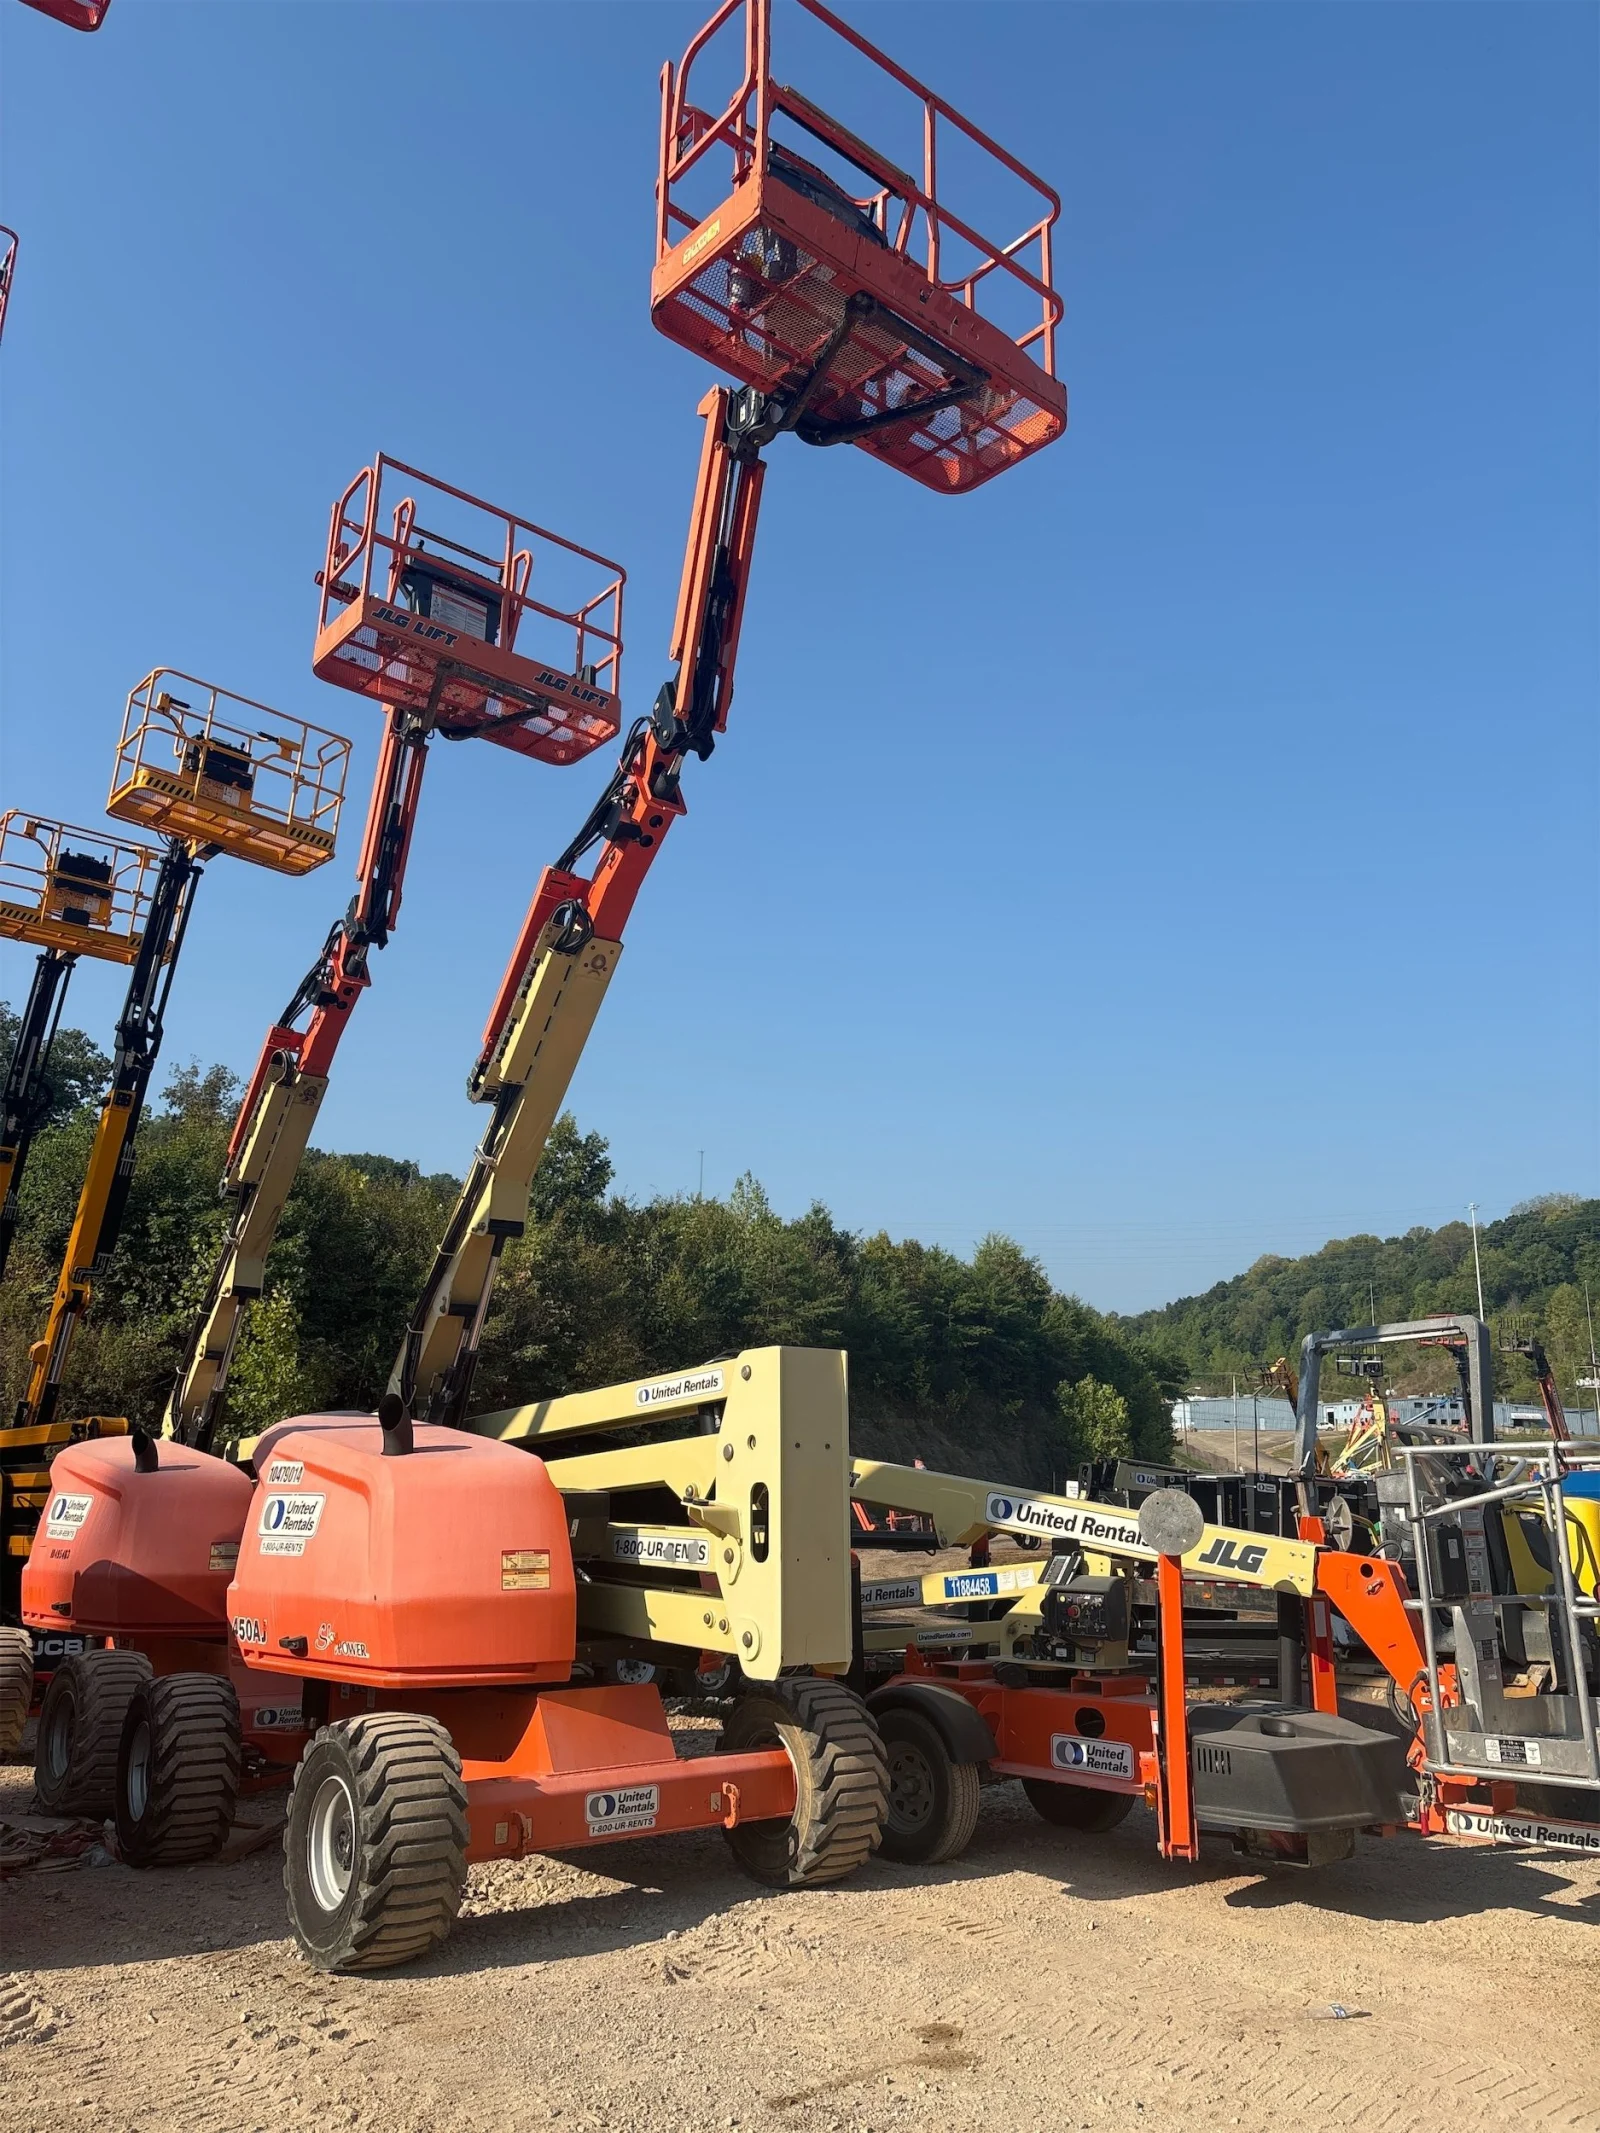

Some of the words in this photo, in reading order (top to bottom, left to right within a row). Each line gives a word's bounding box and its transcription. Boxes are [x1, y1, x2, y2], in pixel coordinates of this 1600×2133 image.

[371, 606, 411, 629] JLG
[413, 620, 458, 646] LIFT
[534, 671, 570, 692] JLG
[570, 684, 609, 708] LIFT
[651, 1382, 682, 1400] United
[684, 1375, 719, 1394] Rentals
[268, 1465, 304, 1483] 10479014
[67, 1499, 89, 1511] United
[286, 1500, 319, 1515] United
[62, 1511, 85, 1523] Rentals
[281, 1516, 315, 1531] Rentals
[1016, 1503, 1078, 1532] United
[261, 1542, 304, 1553] 1-800-UR-RENTS
[614, 1539, 706, 1561] 1-800-UR-ENS
[1197, 1538, 1268, 1574] JLG
[874, 1585, 915, 1601] Rentals
[951, 1577, 991, 1597] 11884458
[917, 1630, 972, 1641] UnitedRentals.com
[33, 1639, 84, 1656] JCB
[1086, 1744, 1125, 1761] United
[1086, 1757, 1129, 1774] Rentals
[617, 1788, 653, 1804] United
[617, 1800, 656, 1815] Rentals
[591, 1817, 653, 1834] 1-800-UR-RENTS
[1477, 1818, 1532, 1839] United
[1536, 1826, 1600, 1848] Rentals
